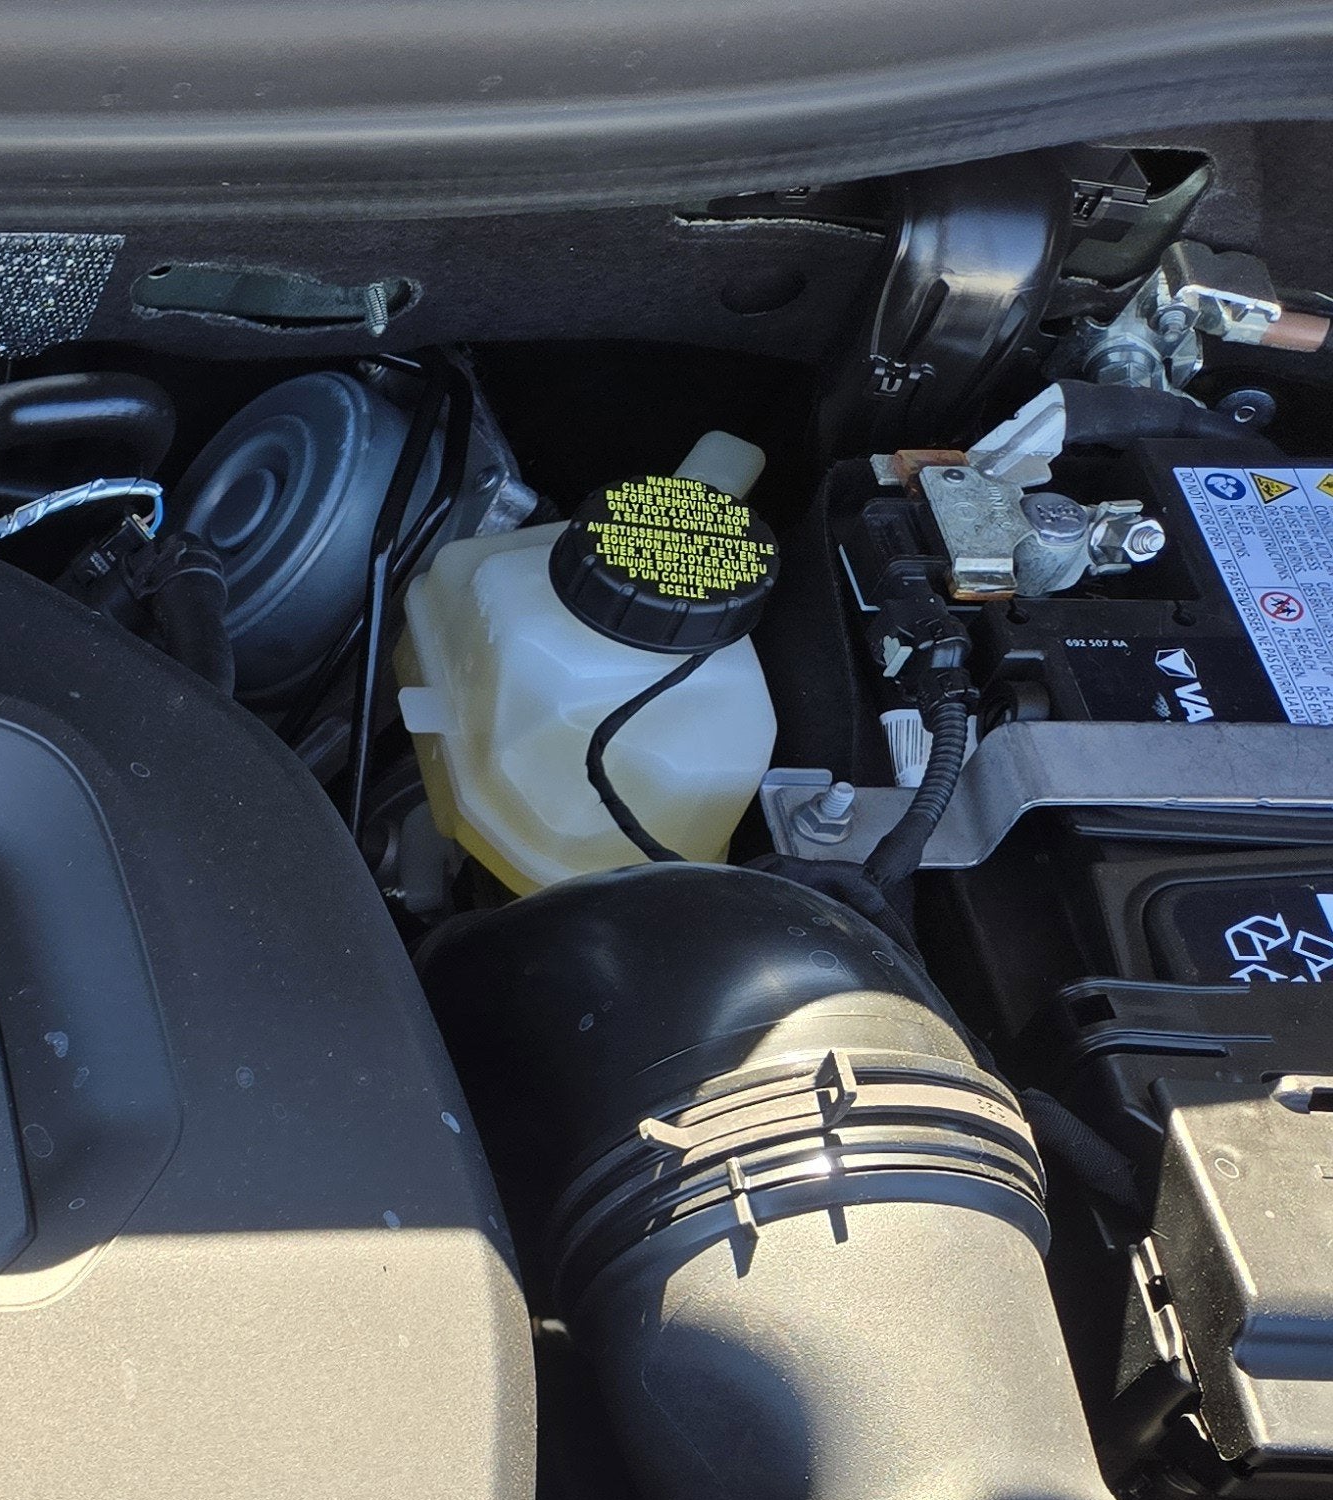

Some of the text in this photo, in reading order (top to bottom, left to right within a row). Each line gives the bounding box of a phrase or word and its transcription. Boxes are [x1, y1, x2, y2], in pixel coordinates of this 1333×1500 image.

[646, 476, 707, 492] WARNING:
[1180, 472, 1195, 482] DO
[622, 482, 732, 505] CLEAN FILLER CAP
[1186, 484, 1204, 498] NOT
[606, 490, 749, 518] BEFORE REMOVING. USE
[608, 501, 750, 527] ONLY DOT 4 FLUID FROM
[1230, 505, 1248, 522] LIRE
[1246, 505, 1265, 525] READ
[612, 511, 747, 537] A SEALED CONTAINER.
[1265, 506, 1280, 517] OR
[1273, 518, 1294, 545] SEVERE
[587, 522, 775, 555] AVERTISSEMENT: NETTOYER LE
[602, 534, 663, 550] BOUCHON
[665, 542, 704, 555] AVANT
[709, 548, 726, 558] DE
[1280, 506, 1323, 571] CAUSE BLINDNESS
[1315, 541, 1333, 559] ACID
[596, 543, 767, 574] LEVER. N'EMPLOYER QUE DU
[606, 555, 654, 570] LIQUIDE
[689, 565, 758, 583] PROVENANT
[629, 567, 736, 591] D'UN CONTENANT
[1065, 638, 1129, 648] 692 507 RA
[1271, 626, 1286, 638] OF
[1303, 627, 1323, 649] KEEP
[1262, 647, 1278, 663] PAS
[1288, 627, 1318, 671] THE REACH
